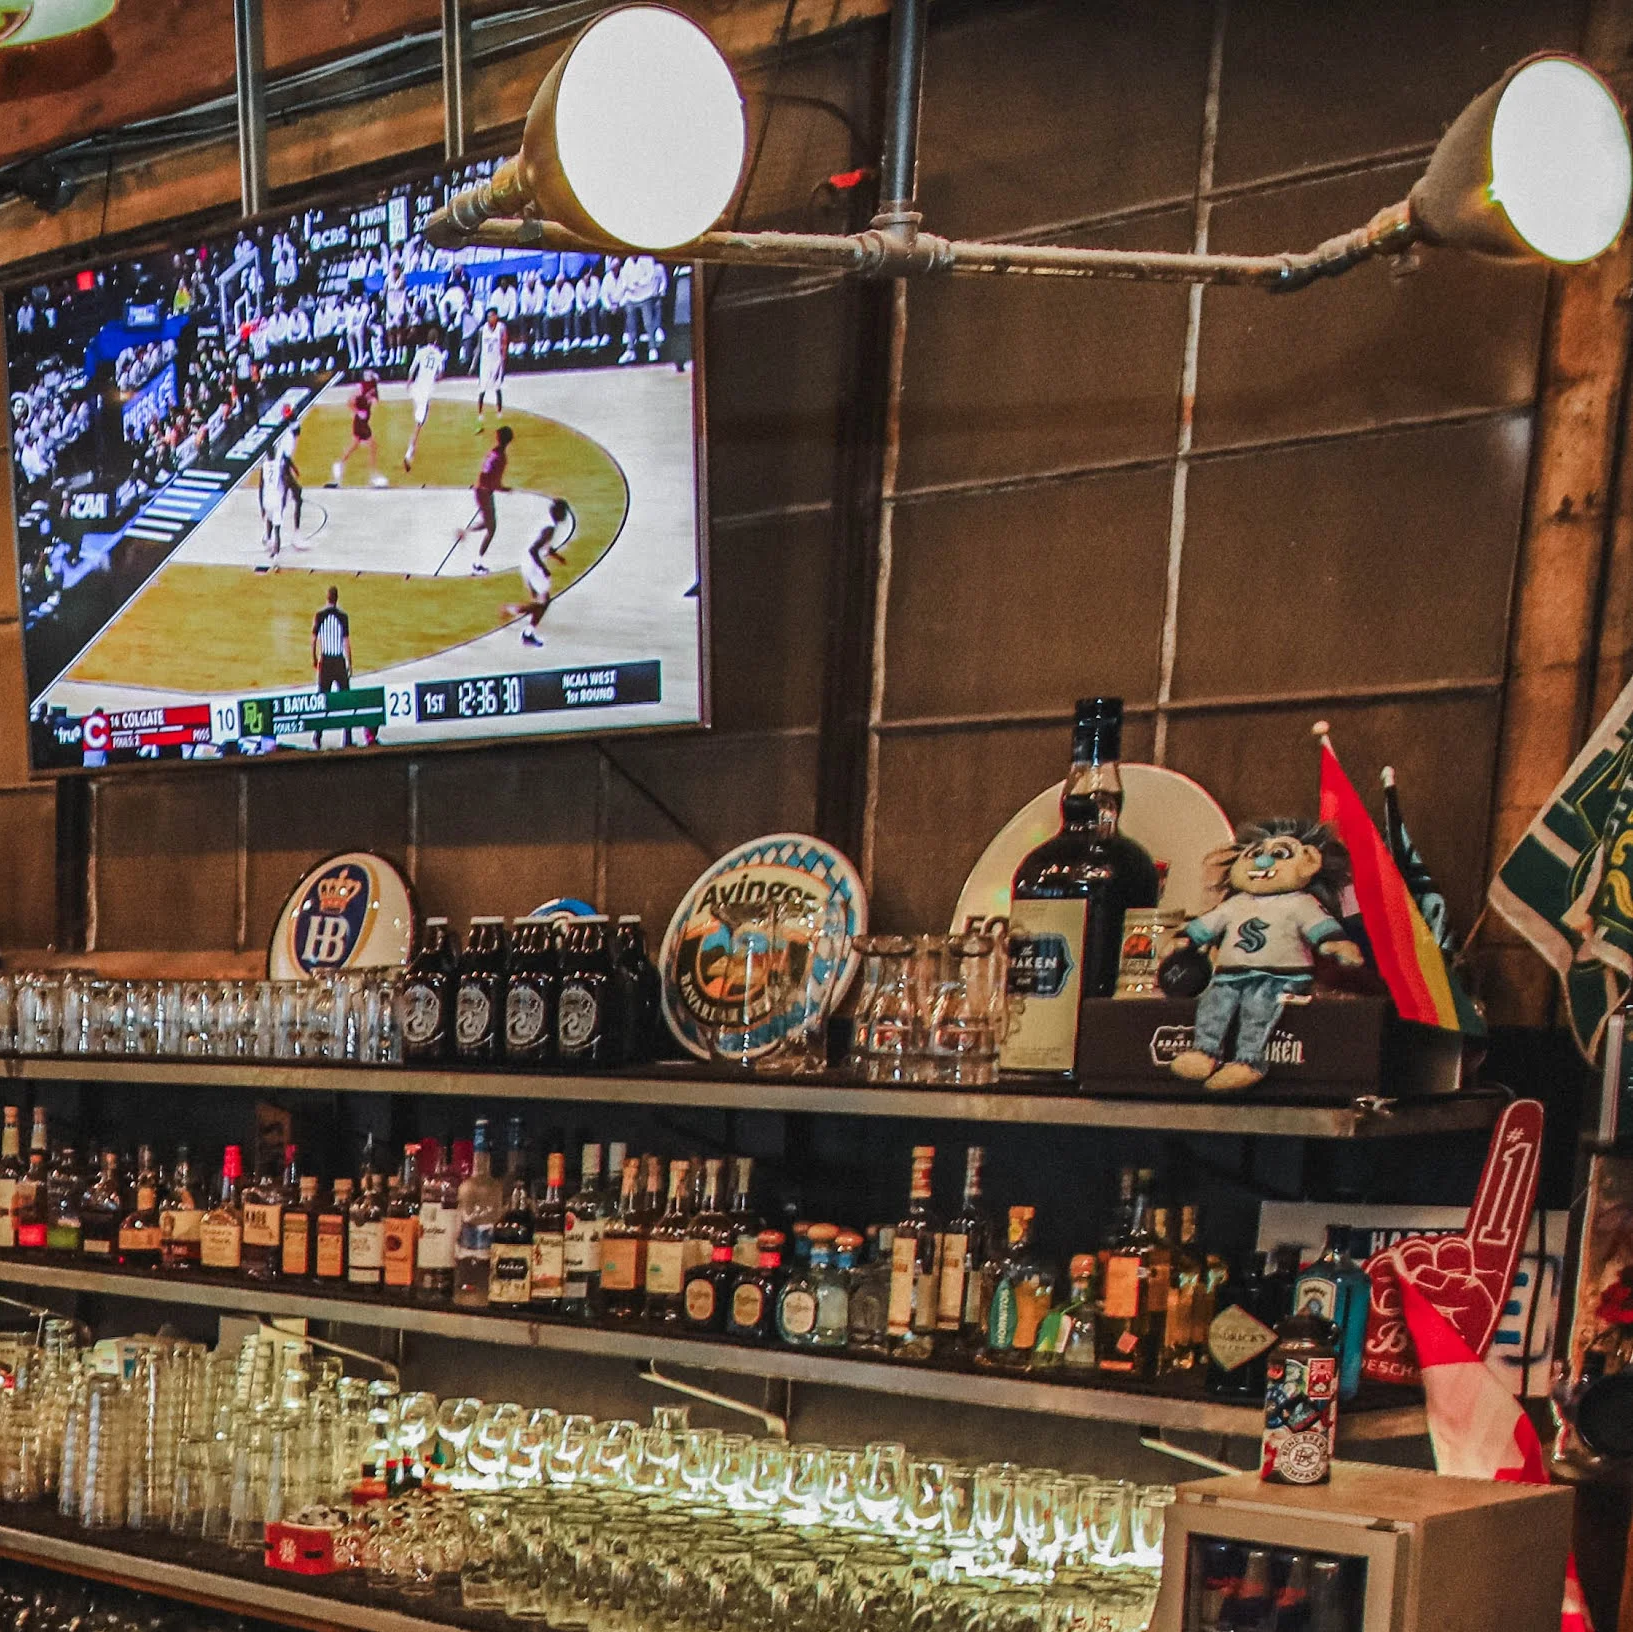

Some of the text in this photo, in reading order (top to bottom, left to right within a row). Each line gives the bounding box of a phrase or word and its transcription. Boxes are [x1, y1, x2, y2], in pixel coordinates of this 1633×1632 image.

[284, 693, 327, 714] BAYLOR
[389, 691, 413, 717] 23
[122, 708, 165, 726] COLGATE
[217, 708, 236, 732] 10
